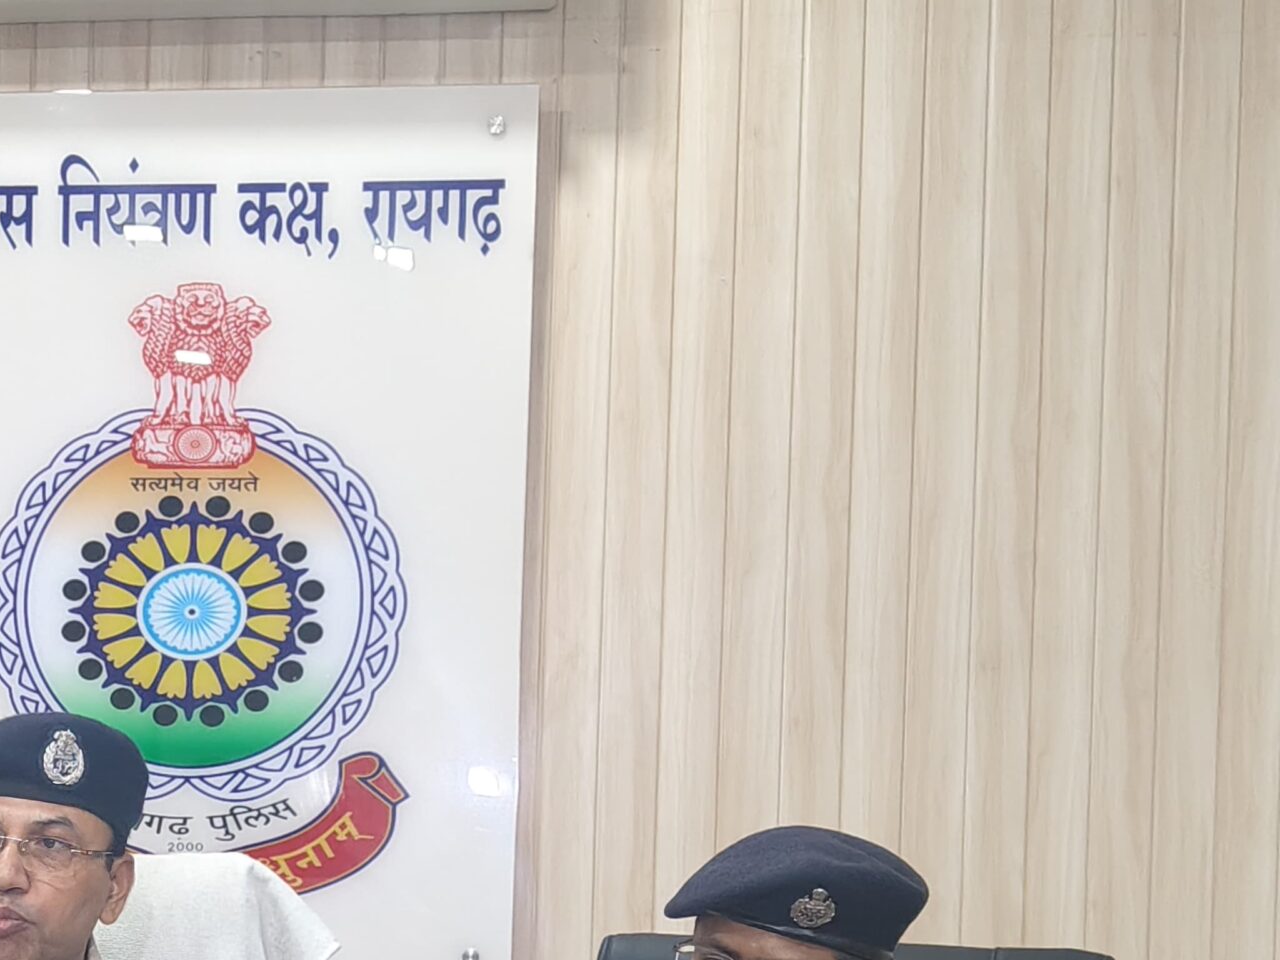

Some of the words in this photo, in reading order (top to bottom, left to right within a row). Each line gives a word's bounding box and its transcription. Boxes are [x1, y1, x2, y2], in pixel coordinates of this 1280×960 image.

[57, 154, 217, 247] नियंत्रण
[238, 180, 341, 258] कक्ष,
[362, 178, 505, 255] रायगढ़
[129, 472, 201, 492] सत्यमेव
[207, 471, 260, 492] जयते
[206, 798, 297, 842] पुलिस
[167, 842, 204, 852] 2000
